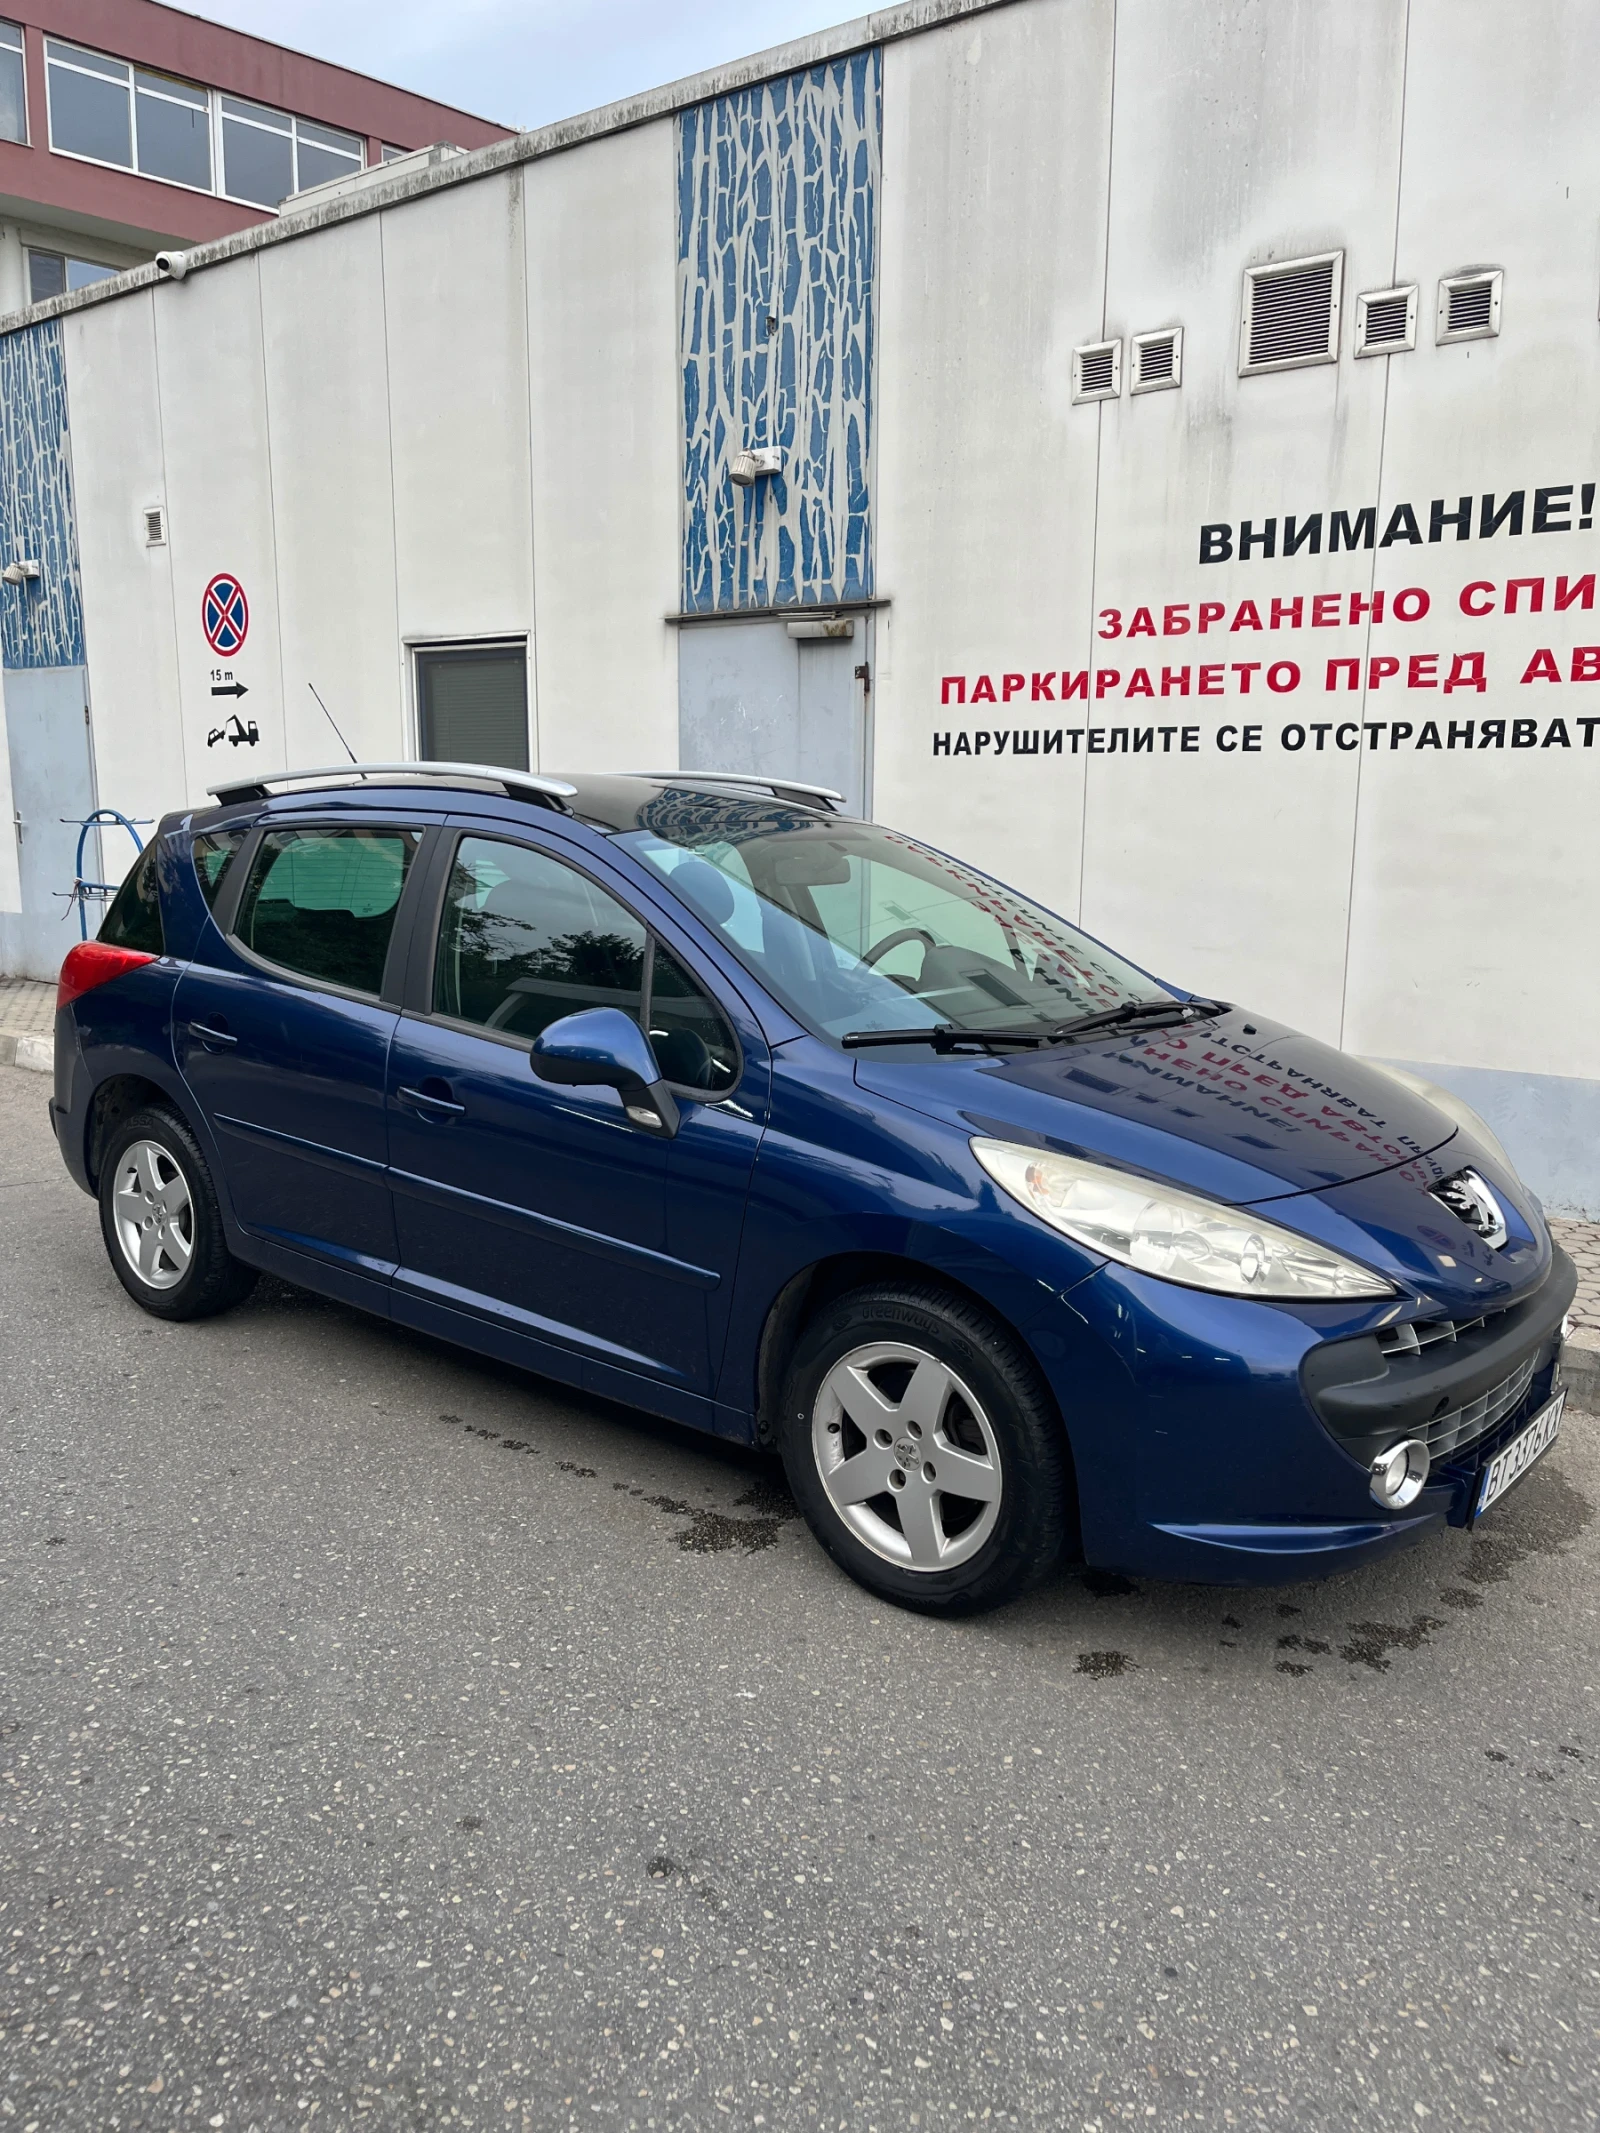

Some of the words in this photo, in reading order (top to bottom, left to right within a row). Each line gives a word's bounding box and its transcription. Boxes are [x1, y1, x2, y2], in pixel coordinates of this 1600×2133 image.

[1198, 482, 1596, 565] ВНИМАНИЕ!
[1097, 587, 1431, 640] ЗАБРАНЕНО
[1458, 573, 1597, 617] СПИ
[210, 669, 221, 681] 15
[940, 661, 1302, 705] ПАРКИРАНЕТО
[1325, 651, 1488, 695] ПРЕД
[1519, 645, 1600, 685] АВ
[932, 725, 1200, 757] НАРУШИТЕЛИТЕ
[1216, 725, 1263, 752] СЕ
[1281, 717, 1600, 751] ОТСТРАНЯВАТ
